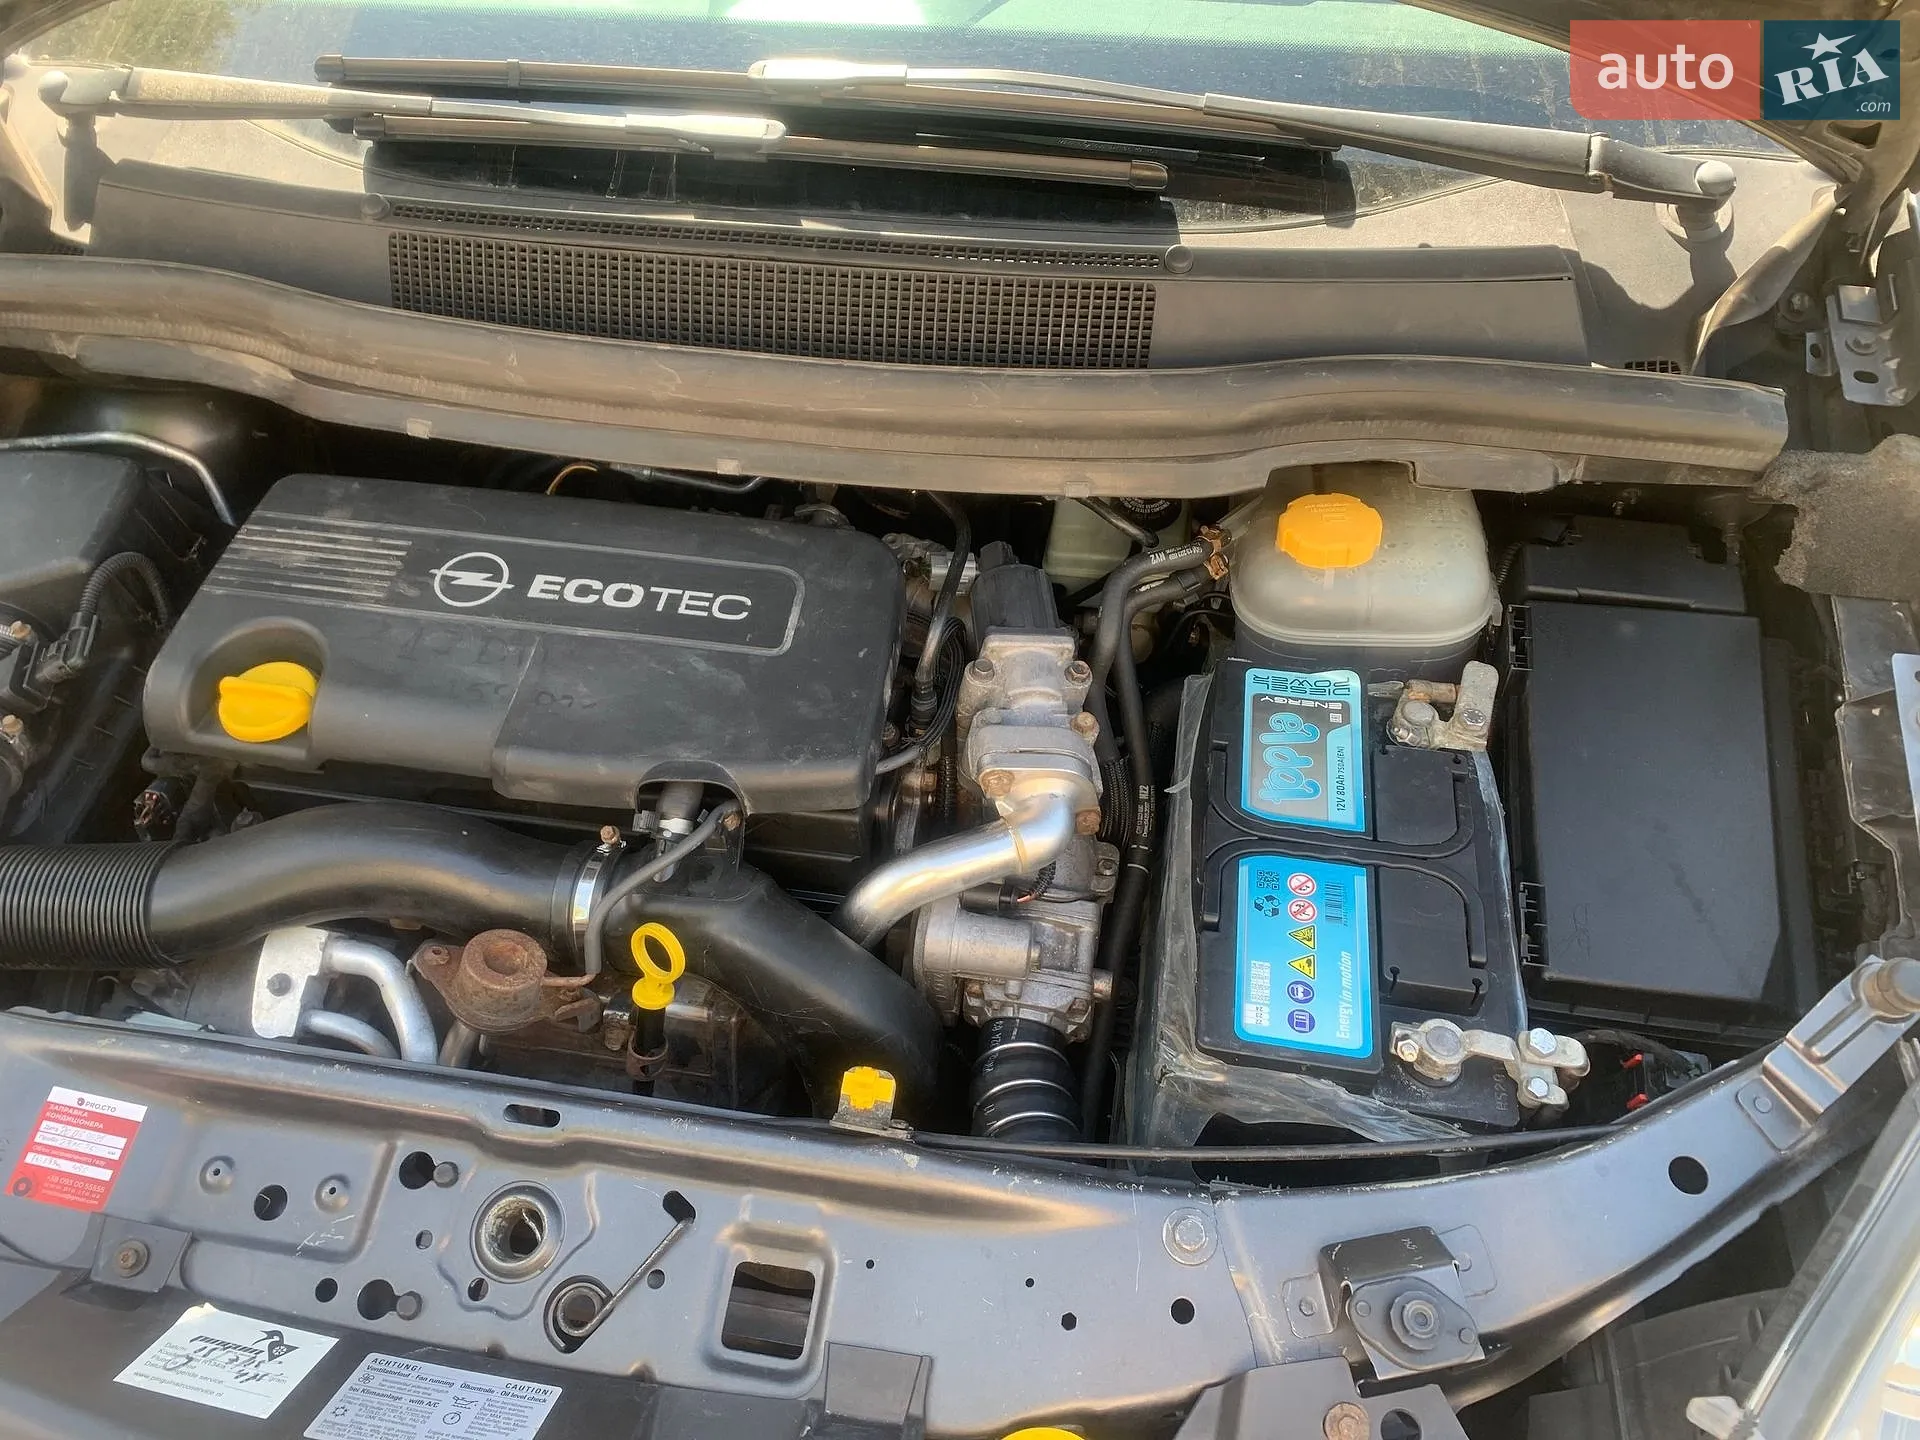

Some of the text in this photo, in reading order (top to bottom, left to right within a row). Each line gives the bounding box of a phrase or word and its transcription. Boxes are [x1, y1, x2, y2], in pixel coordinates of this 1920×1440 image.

[527, 574, 752, 621] ECOTEC
[1253, 681, 1351, 696] DIESEL
[1261, 695, 1343, 710] ENERGY
[1336, 774, 1346, 796] 80Ah
[1336, 797, 1346, 812] 12V
[1336, 951, 1353, 1039] Energy in motion
[371, 1358, 422, 1372] ACHTUNG!
[366, 1364, 411, 1378] Ventilatorlauf
[415, 1374, 428, 1382] Fan
[428, 1378, 455, 1388] running
[500, 1390, 510, 1398] Oil
[511, 1392, 527, 1400] level
[527, 1395, 547, 1403] check
[505, 1383, 554, 1396] CAUTION!
[360, 1388, 403, 1401] Klimaanlage
[425, 1400, 440, 1408] A/C
